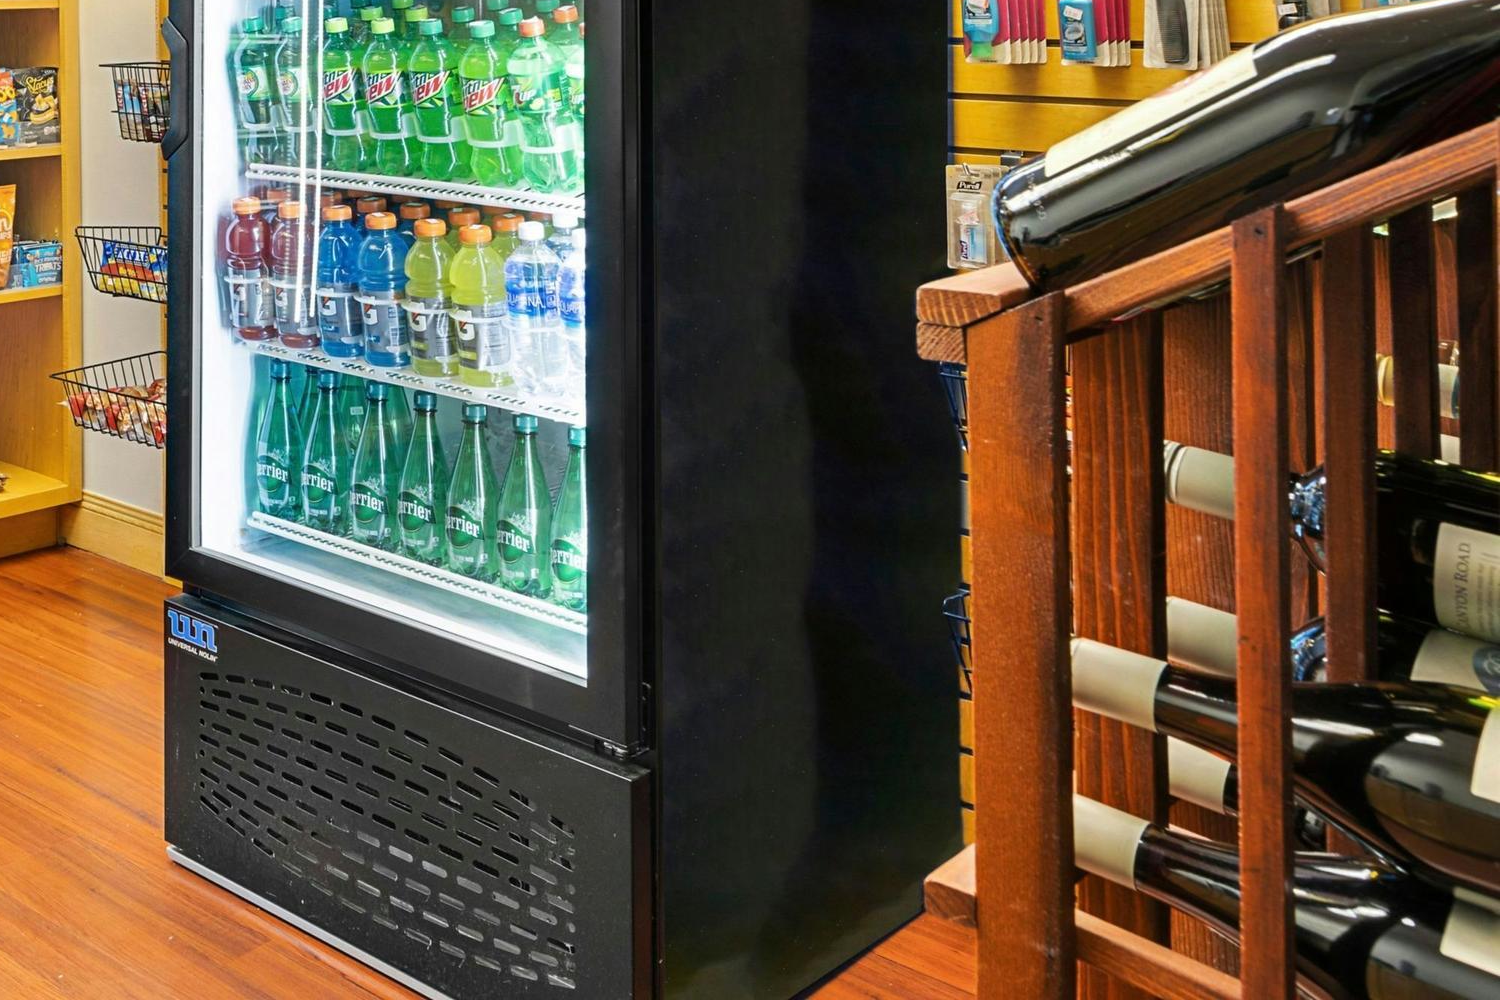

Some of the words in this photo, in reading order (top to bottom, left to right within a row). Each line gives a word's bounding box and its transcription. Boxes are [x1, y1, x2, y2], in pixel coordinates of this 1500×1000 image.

[26, 77, 55, 97] Stacy's
[957, 181, 982, 191] Purell
[34, 260, 61, 273] TREATS
[1452, 542, 1472, 582] ROAD
